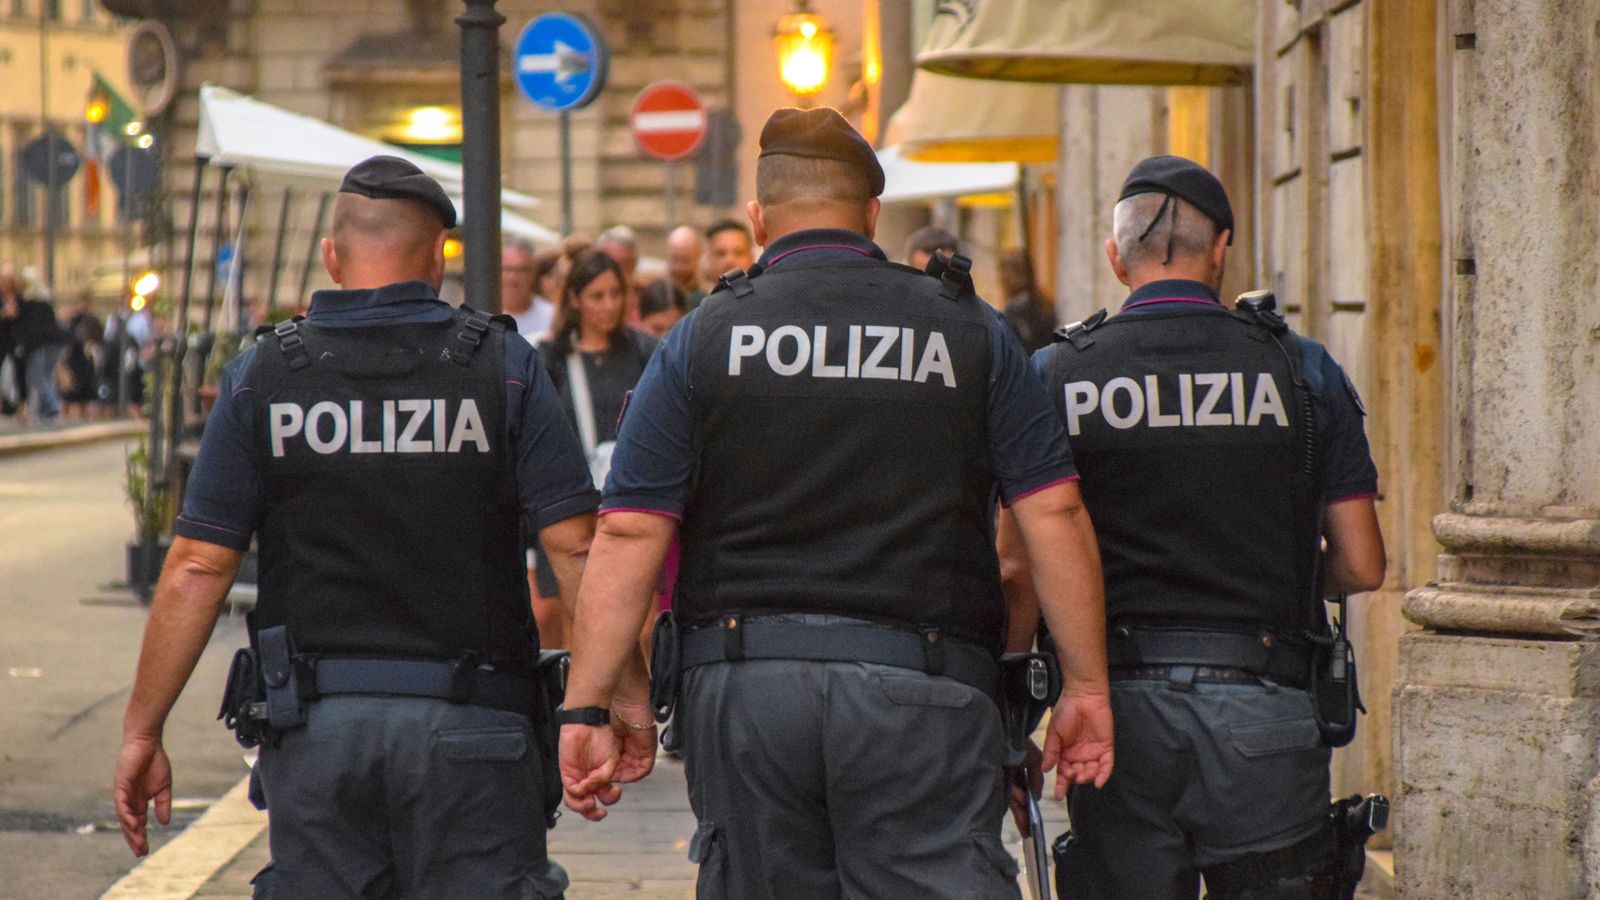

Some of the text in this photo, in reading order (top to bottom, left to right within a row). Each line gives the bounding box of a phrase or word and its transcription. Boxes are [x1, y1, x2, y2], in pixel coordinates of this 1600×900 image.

[728, 324, 957, 388] POLIZIA
[269, 398, 490, 457] POLIZIA
[1064, 372, 1289, 436] POLIZIA
